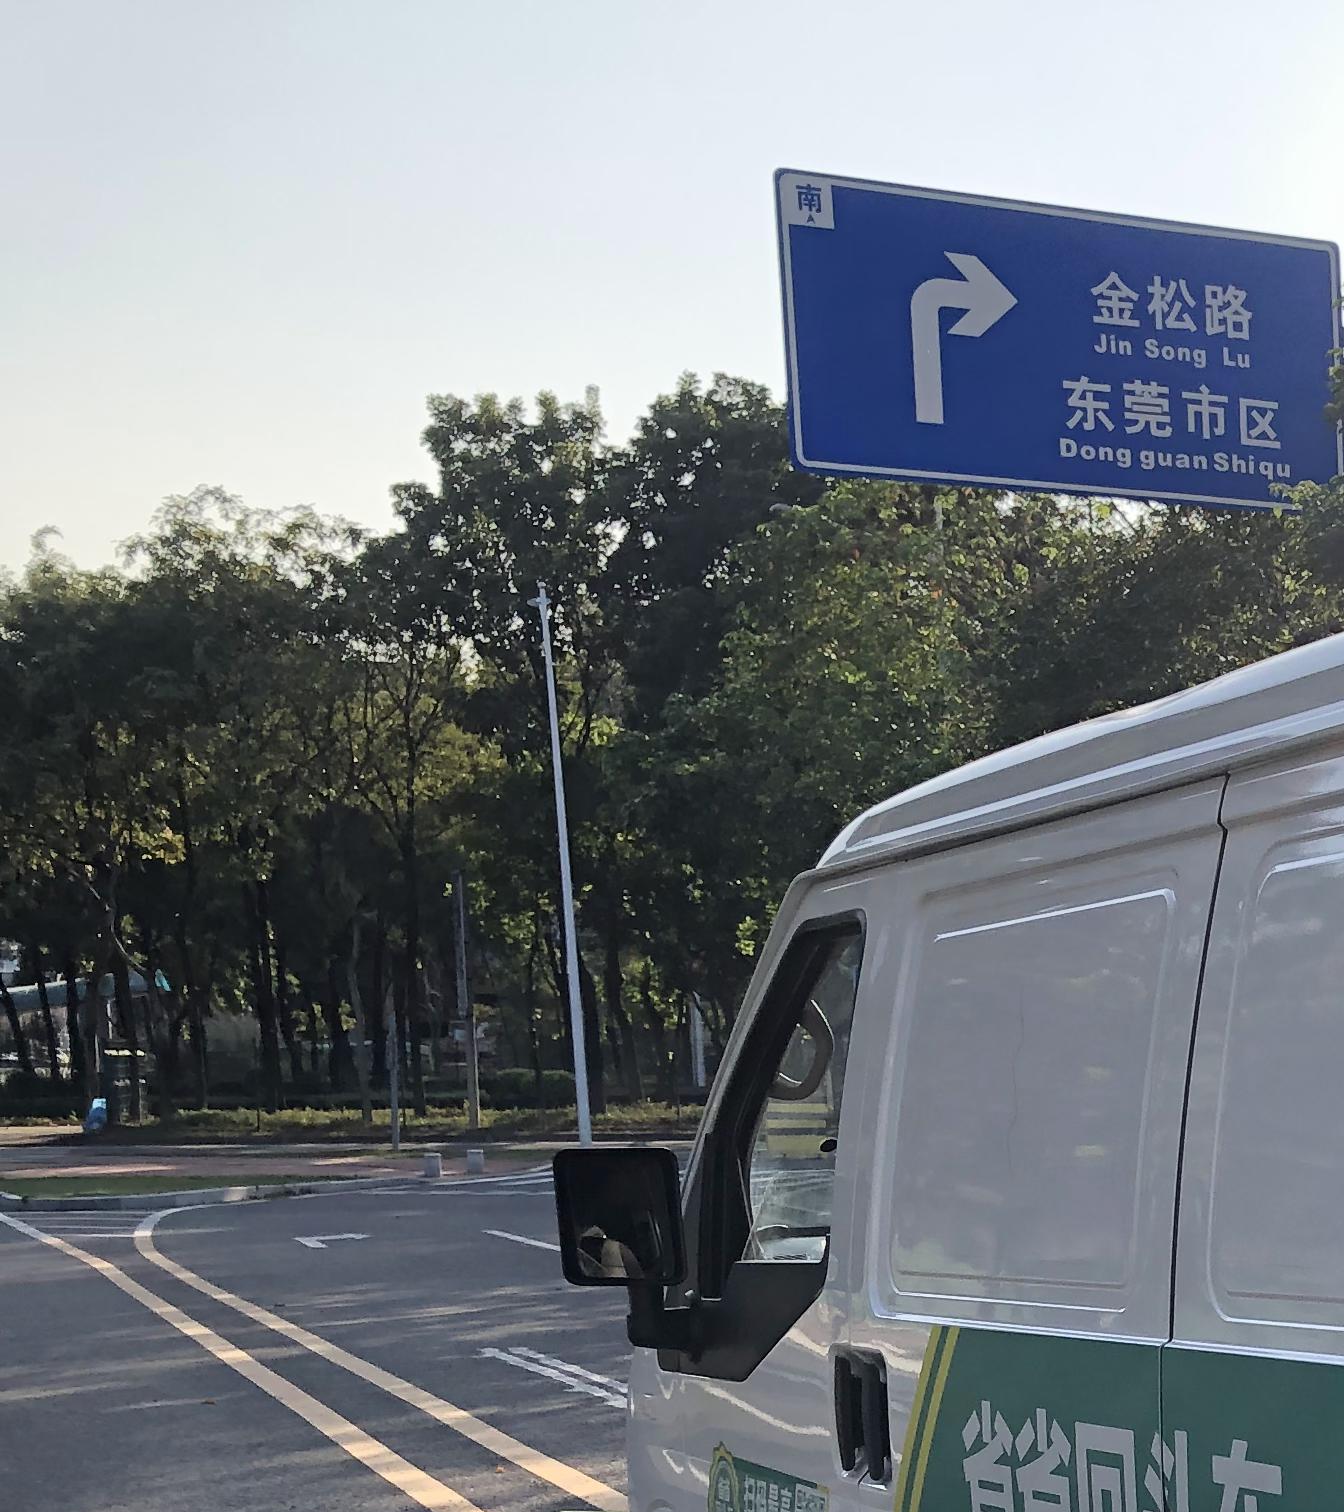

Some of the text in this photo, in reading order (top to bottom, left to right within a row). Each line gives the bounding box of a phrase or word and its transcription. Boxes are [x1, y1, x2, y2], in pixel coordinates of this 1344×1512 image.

[796, 184, 822, 213] 南
[1091, 271, 1252, 340] 金松路
[1094, 333, 1251, 369] Jin Song Lu
[1062, 376, 1282, 449] 东莞市区
